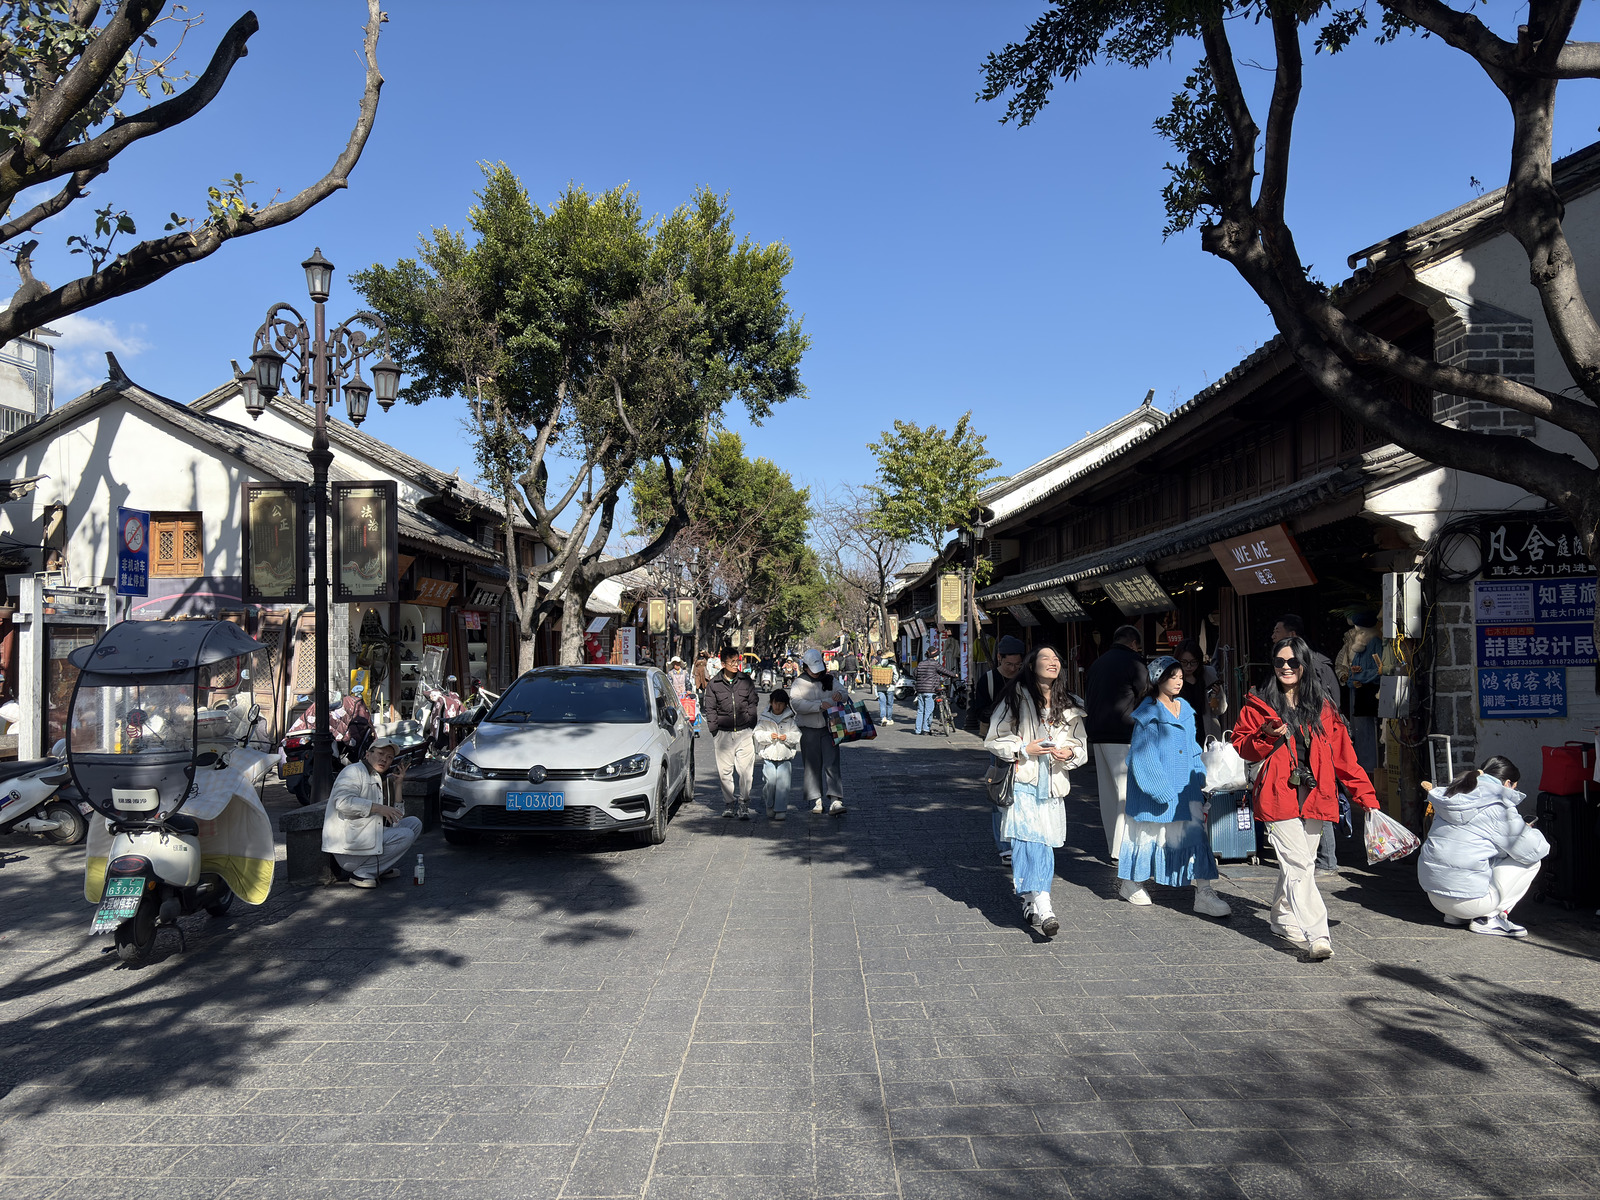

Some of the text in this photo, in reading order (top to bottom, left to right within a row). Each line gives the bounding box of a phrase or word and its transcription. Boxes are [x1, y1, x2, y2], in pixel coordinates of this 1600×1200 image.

[271, 504, 290, 531] 公正
[361, 504, 379, 532] 法治
[1231, 540, 1272, 564] WE ME
[121, 558, 146, 573] 非机动车
[121, 572, 145, 588] 禁止停放
[1485, 635, 1594, 658] 喆墅设计民
[1481, 670, 1563, 692] 鸿福客栈
